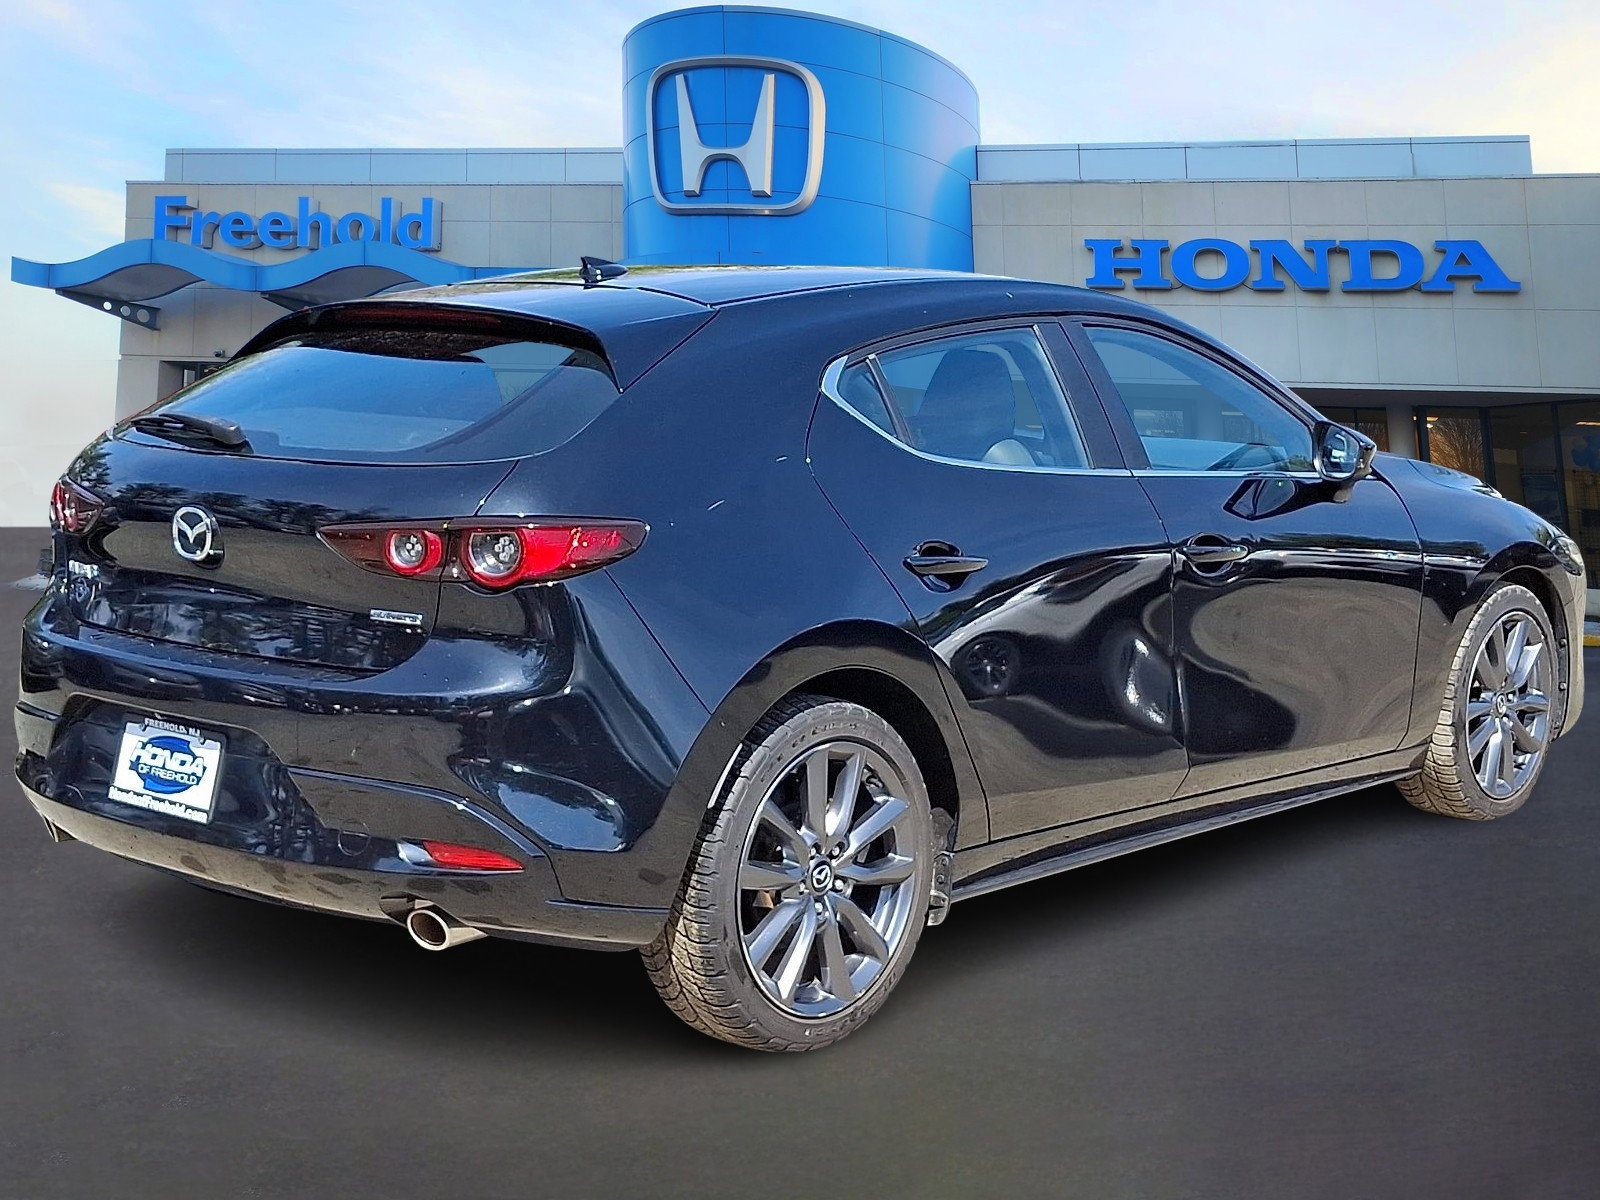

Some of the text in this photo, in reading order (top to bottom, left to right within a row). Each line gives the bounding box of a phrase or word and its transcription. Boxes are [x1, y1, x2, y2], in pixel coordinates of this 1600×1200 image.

[153, 195, 442, 250] Freehold
[1084, 238, 1521, 293] HONDA
[130, 740, 205, 777] HONDA
[138, 763, 199, 785] OF FREEHOLD
